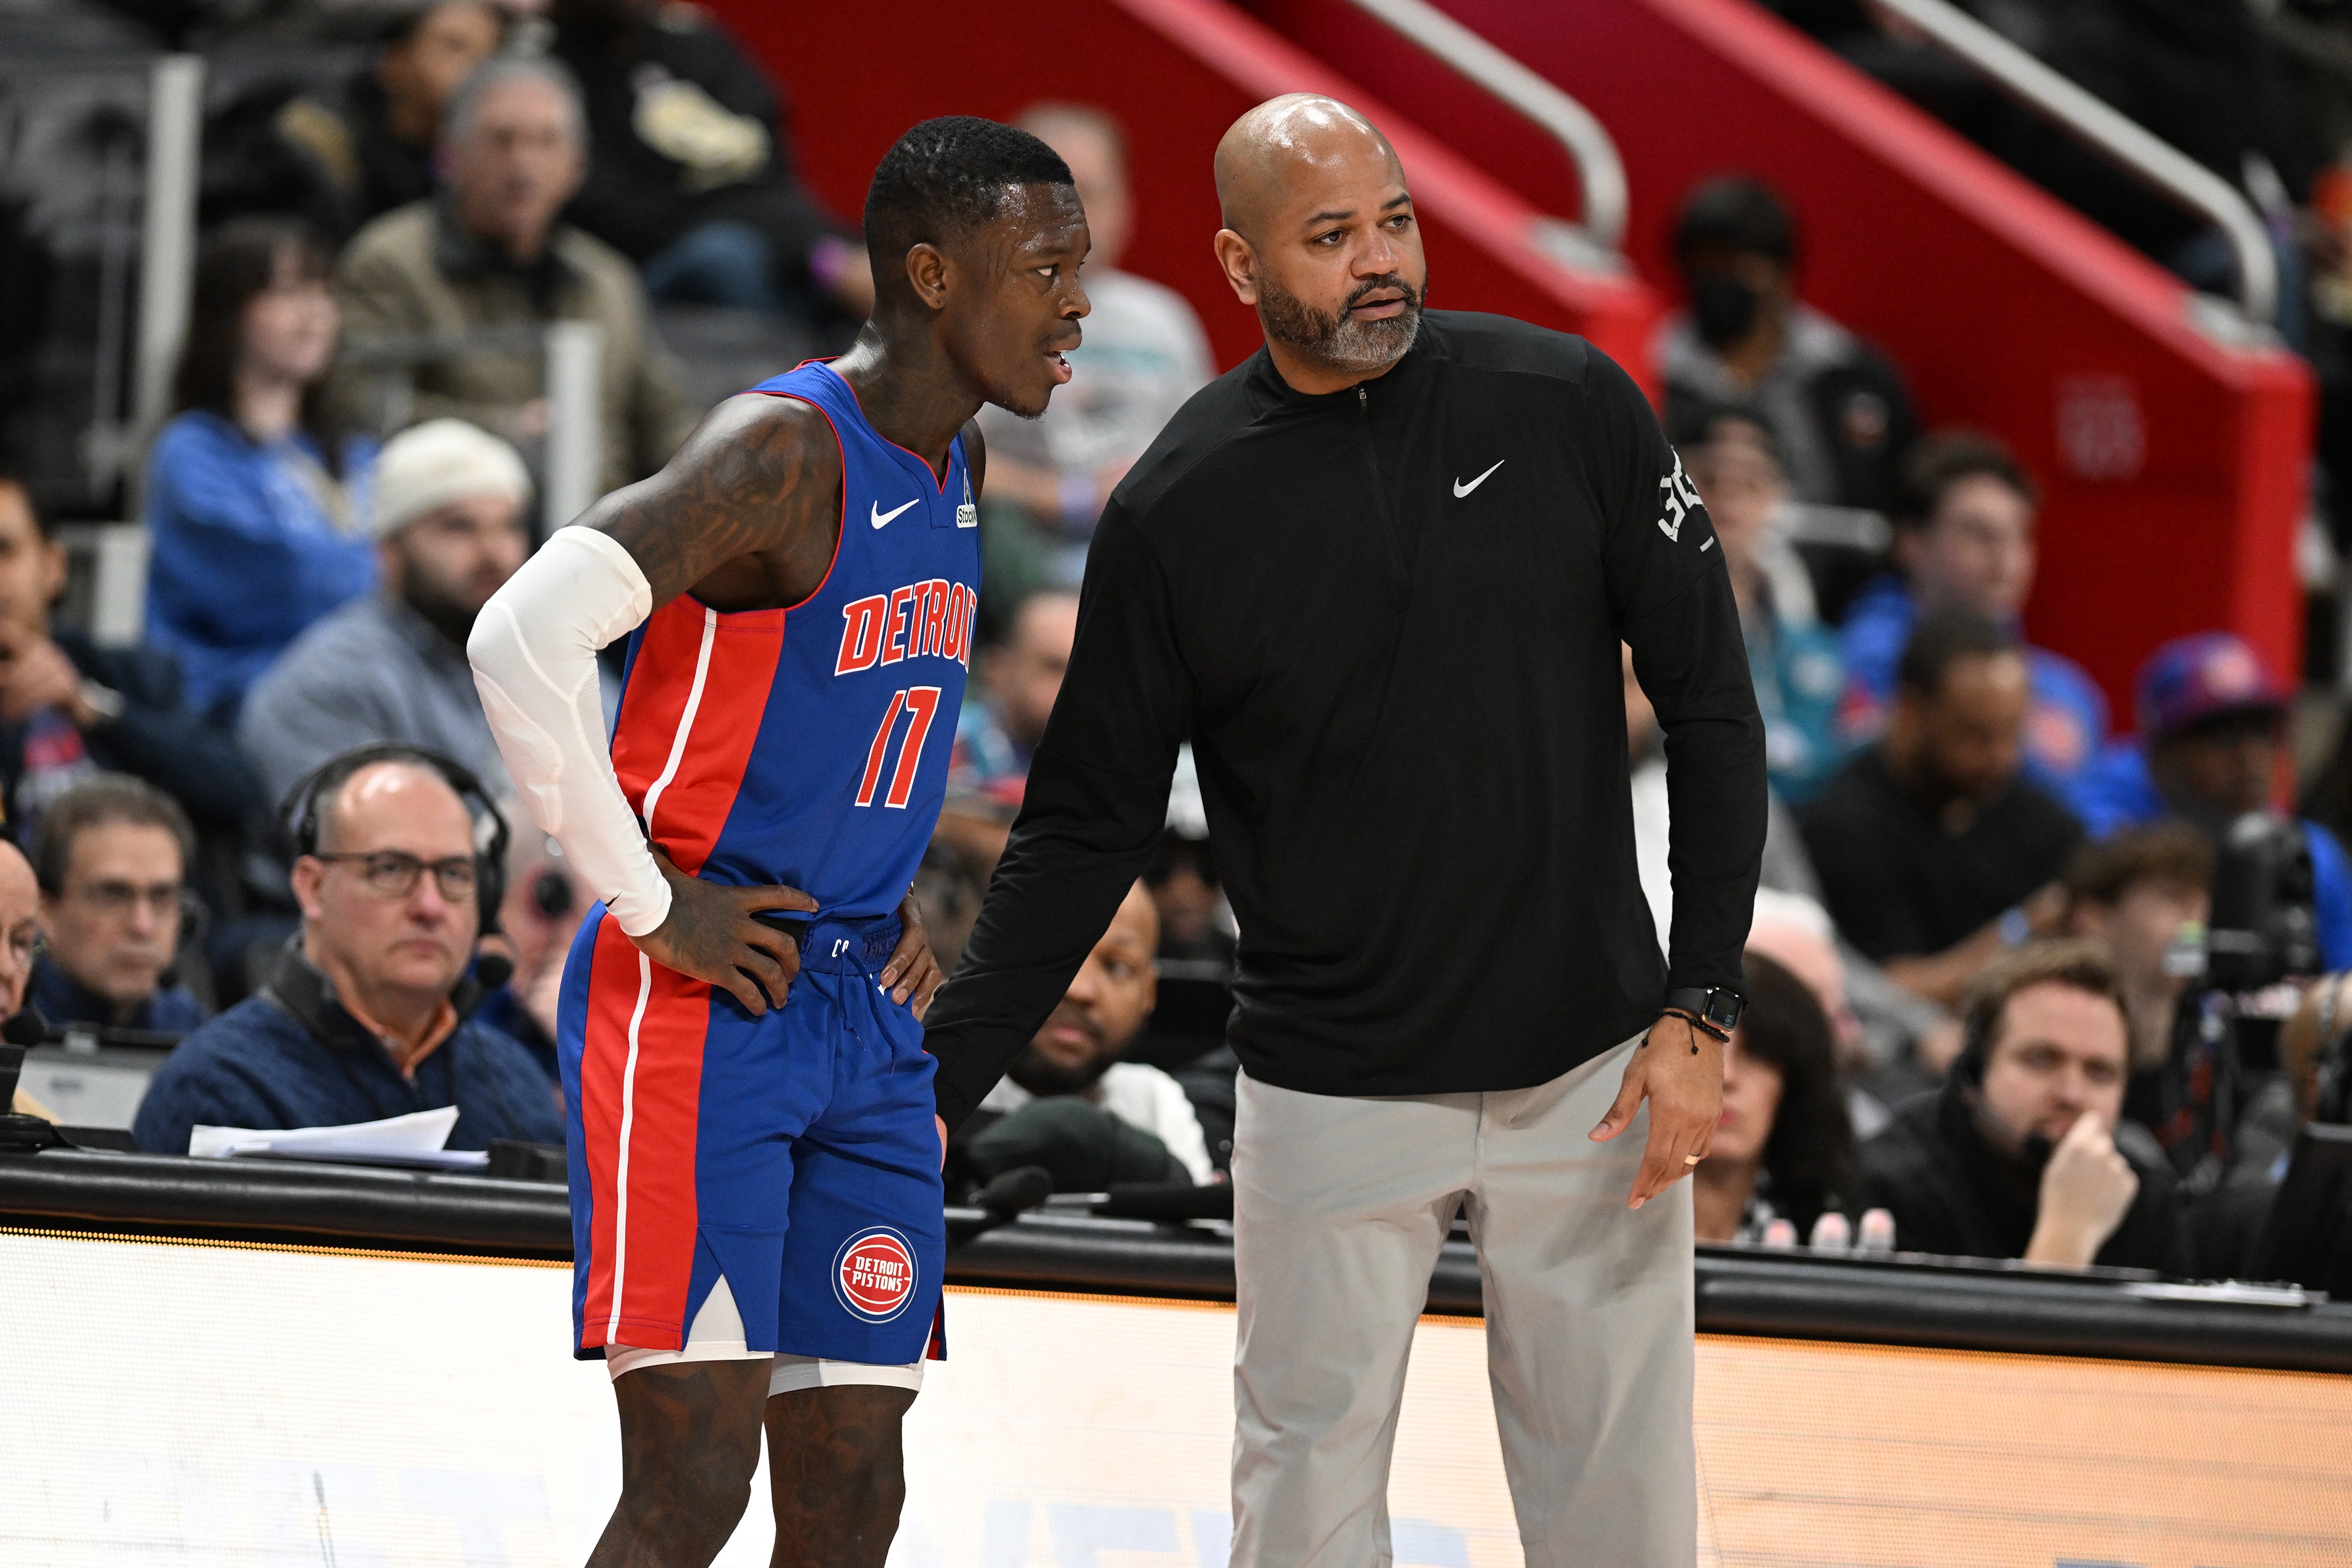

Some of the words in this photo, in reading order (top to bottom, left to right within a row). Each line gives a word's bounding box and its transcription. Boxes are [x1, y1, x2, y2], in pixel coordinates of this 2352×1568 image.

[834, 578, 977, 676] DETROIT
[855, 686, 941, 809] 17
[852, 1271, 903, 1292] PISTONS
[855, 1256, 904, 1277] DETROIT
